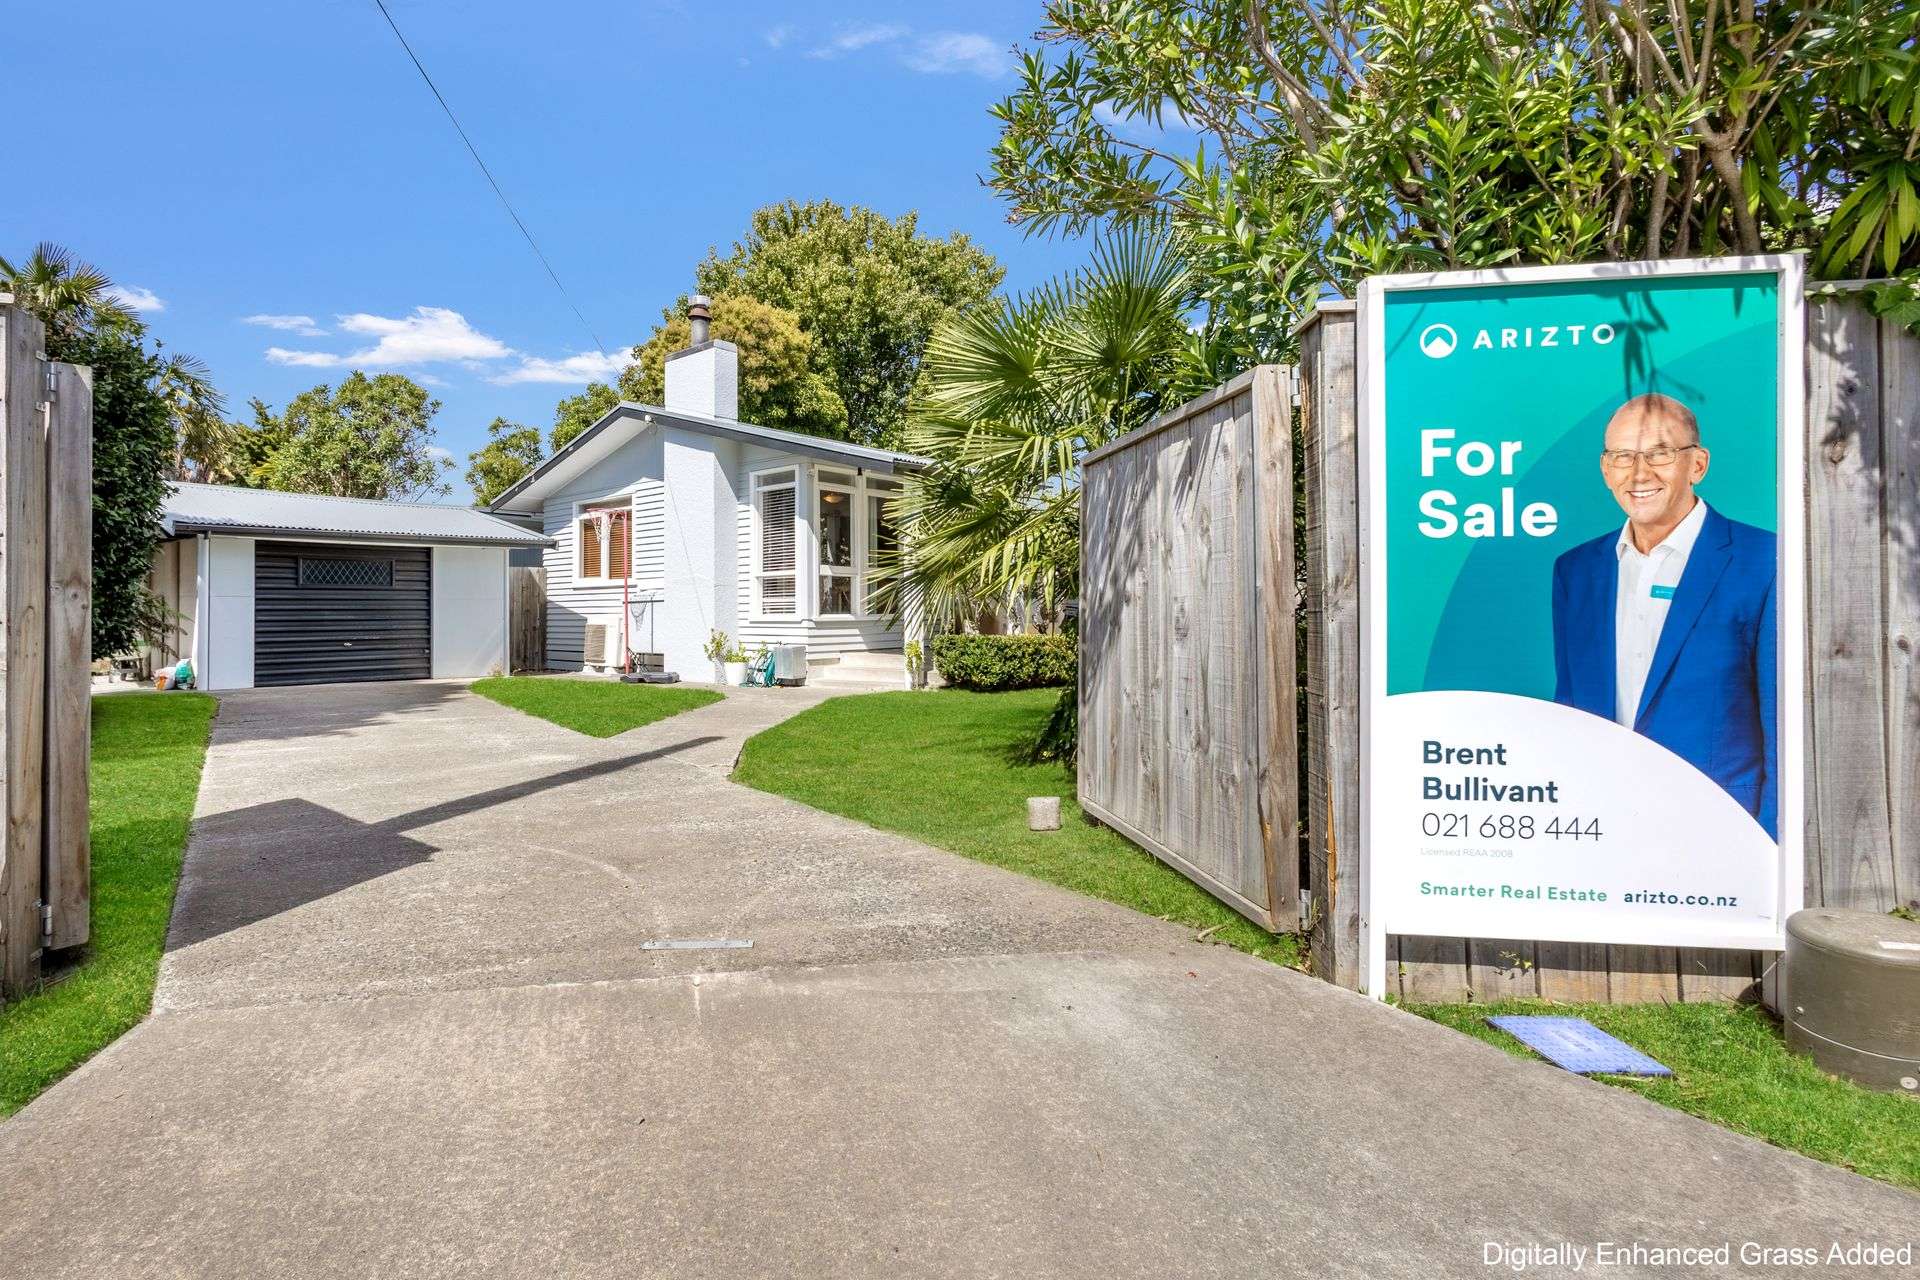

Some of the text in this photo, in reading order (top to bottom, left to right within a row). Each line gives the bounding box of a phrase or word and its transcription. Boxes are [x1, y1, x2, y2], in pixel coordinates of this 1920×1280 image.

[1473, 324, 1615, 349] ARIZTO
[1420, 428, 1523, 478] For
[1417, 487, 1559, 539] Sale
[1422, 740, 1507, 766] Brent
[1422, 776, 1559, 804] Bullivant
[1421, 812, 1604, 842] 021 688 444
[1420, 881, 1608, 902] Smarter Real Estate
[1623, 889, 1738, 907] arizto.co.nz
